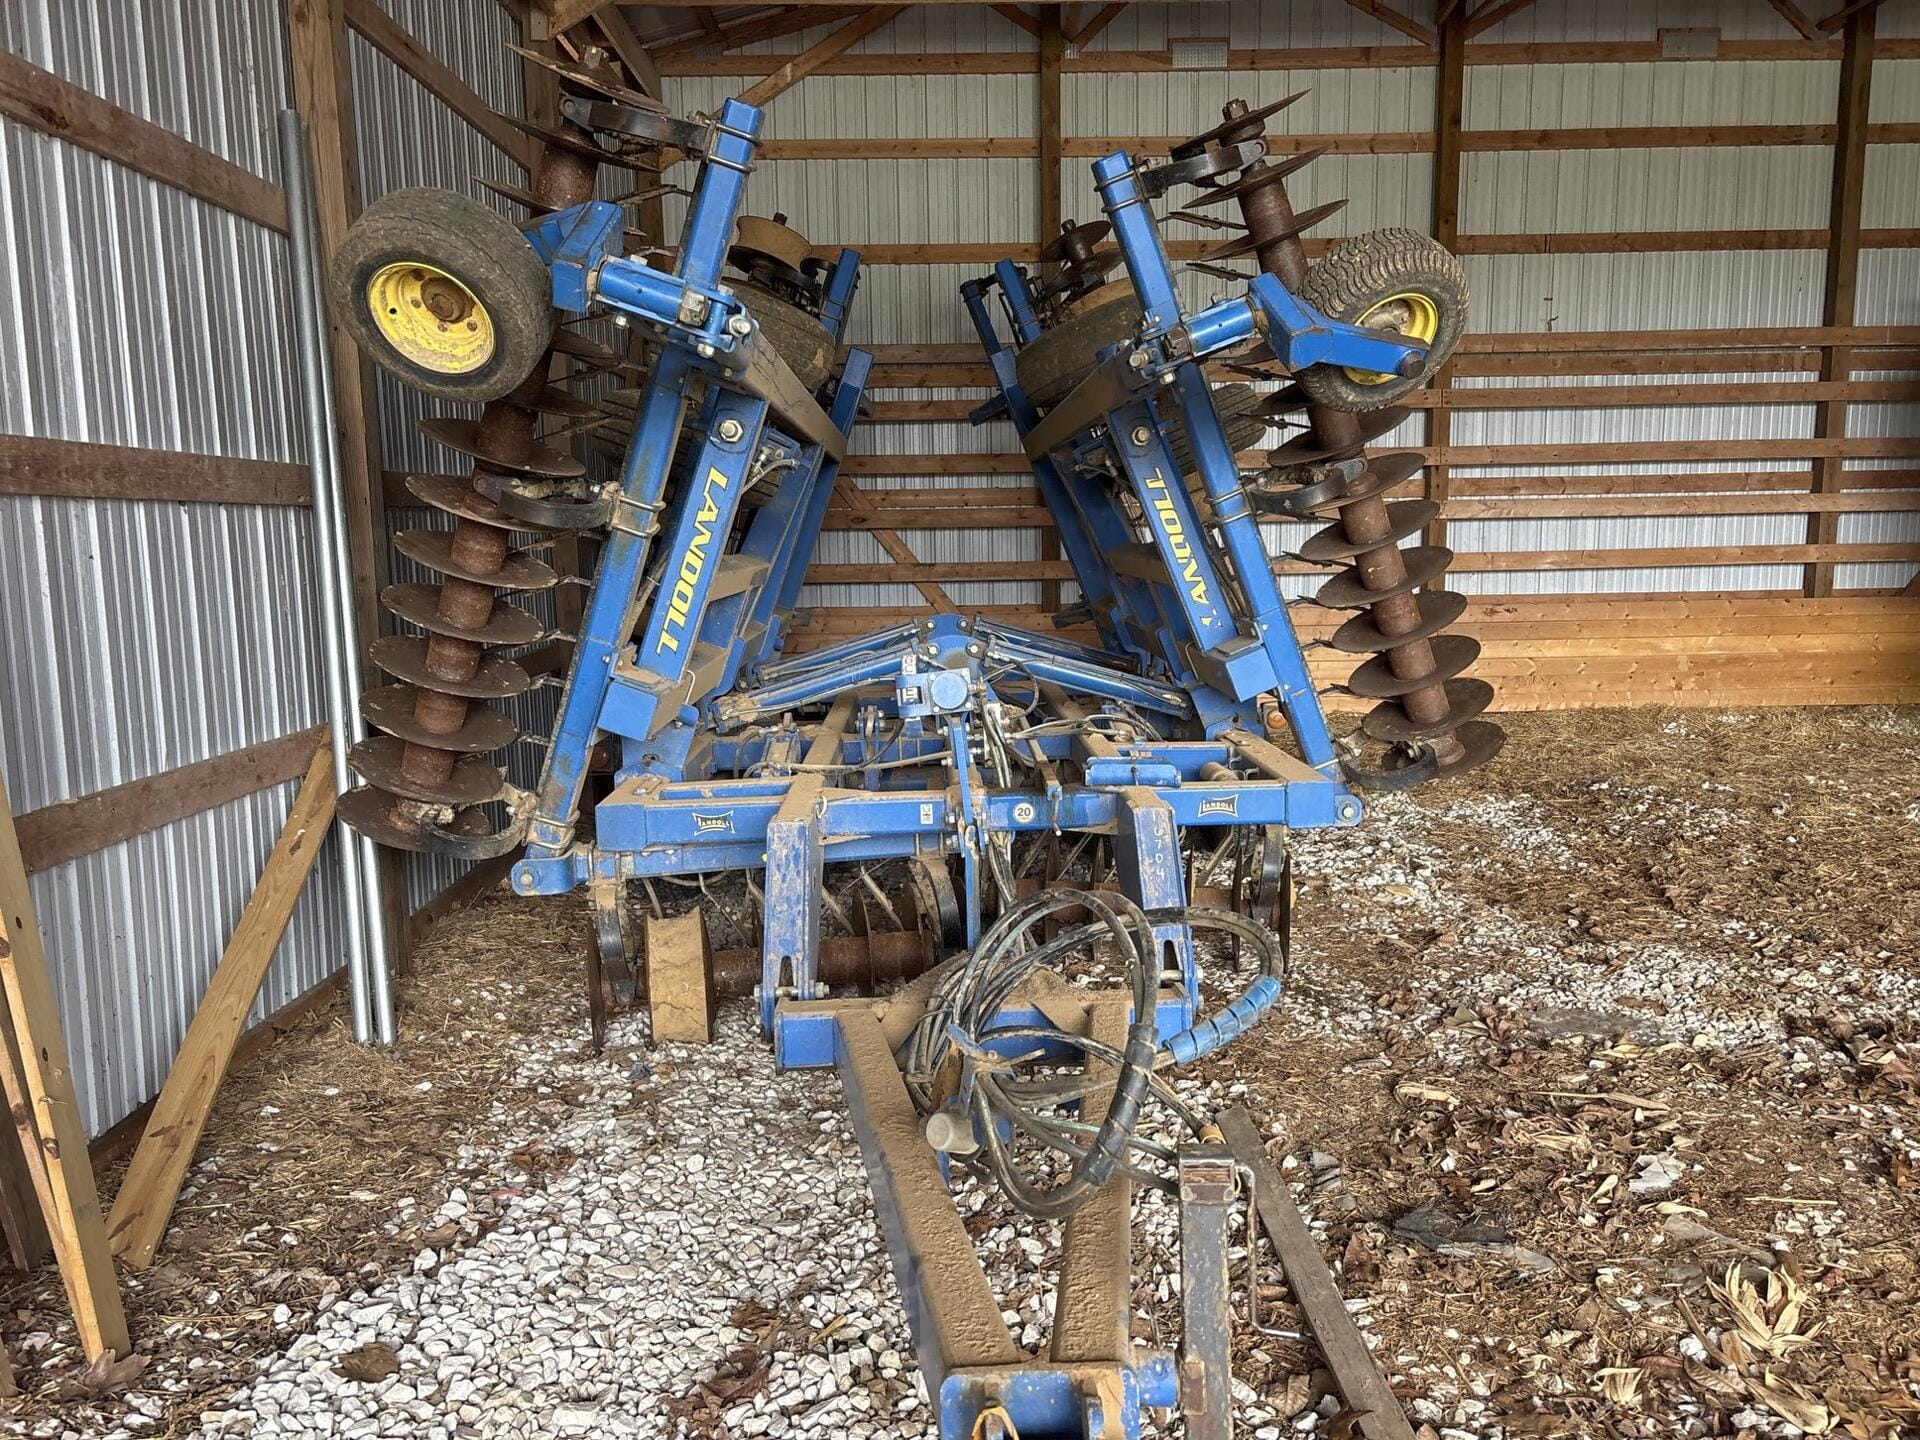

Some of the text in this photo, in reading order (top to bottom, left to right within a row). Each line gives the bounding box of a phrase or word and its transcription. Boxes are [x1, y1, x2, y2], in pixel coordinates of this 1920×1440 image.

[656, 466, 729, 655] LANDOLL
[1145, 467, 1224, 628] ANDOLL
[1017, 806, 1031, 818] 20
